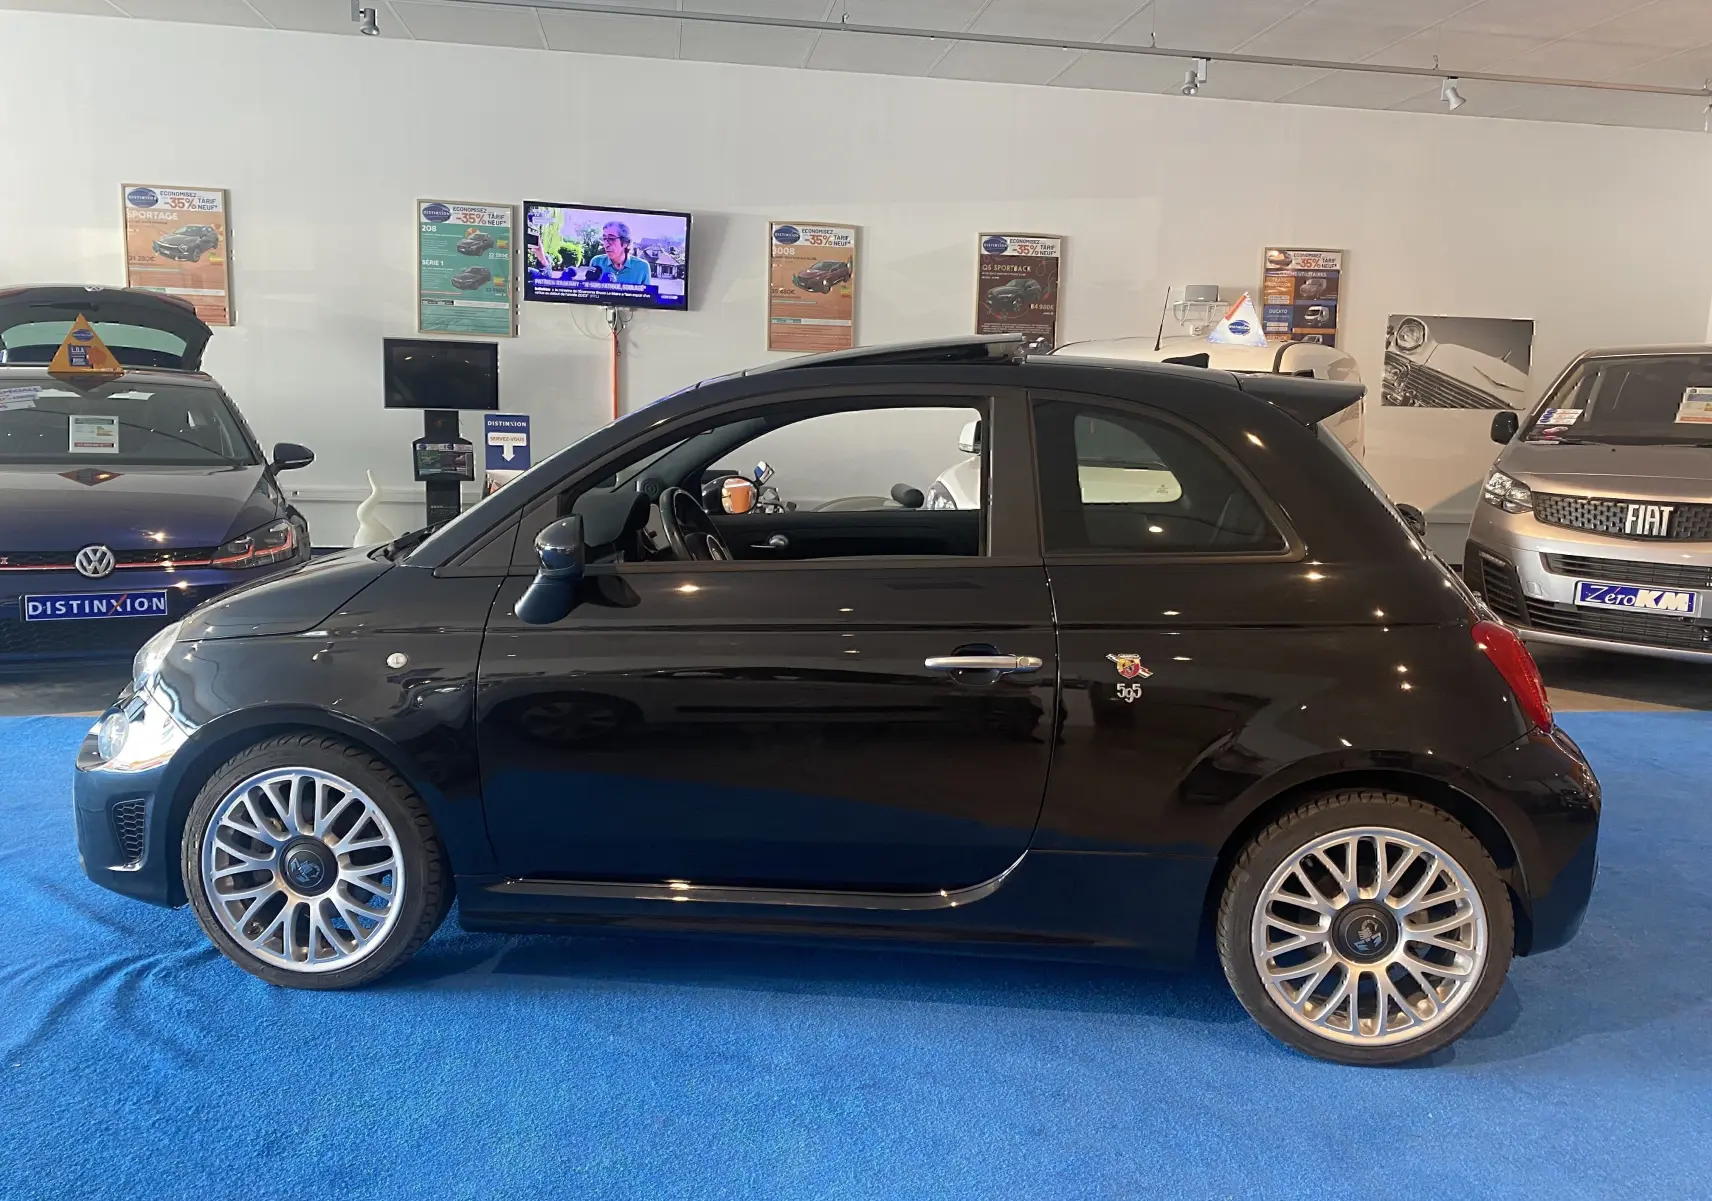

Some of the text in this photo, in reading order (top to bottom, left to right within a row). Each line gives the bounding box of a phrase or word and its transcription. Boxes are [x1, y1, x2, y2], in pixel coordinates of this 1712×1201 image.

[165, 198, 197, 209] -35%
[126, 210, 179, 220] SPORTAGE
[457, 213, 487, 225] -35%
[805, 235, 832, 246] -35%
[1013, 245, 1039, 255] -35%
[994, 264, 1031, 272] SPORTBACK
[1296, 258, 1321, 268] -35%
[1625, 504, 1674, 536] FIAT
[30, 594, 166, 618] DISTINXION
[1116, 683, 1142, 703] 595
